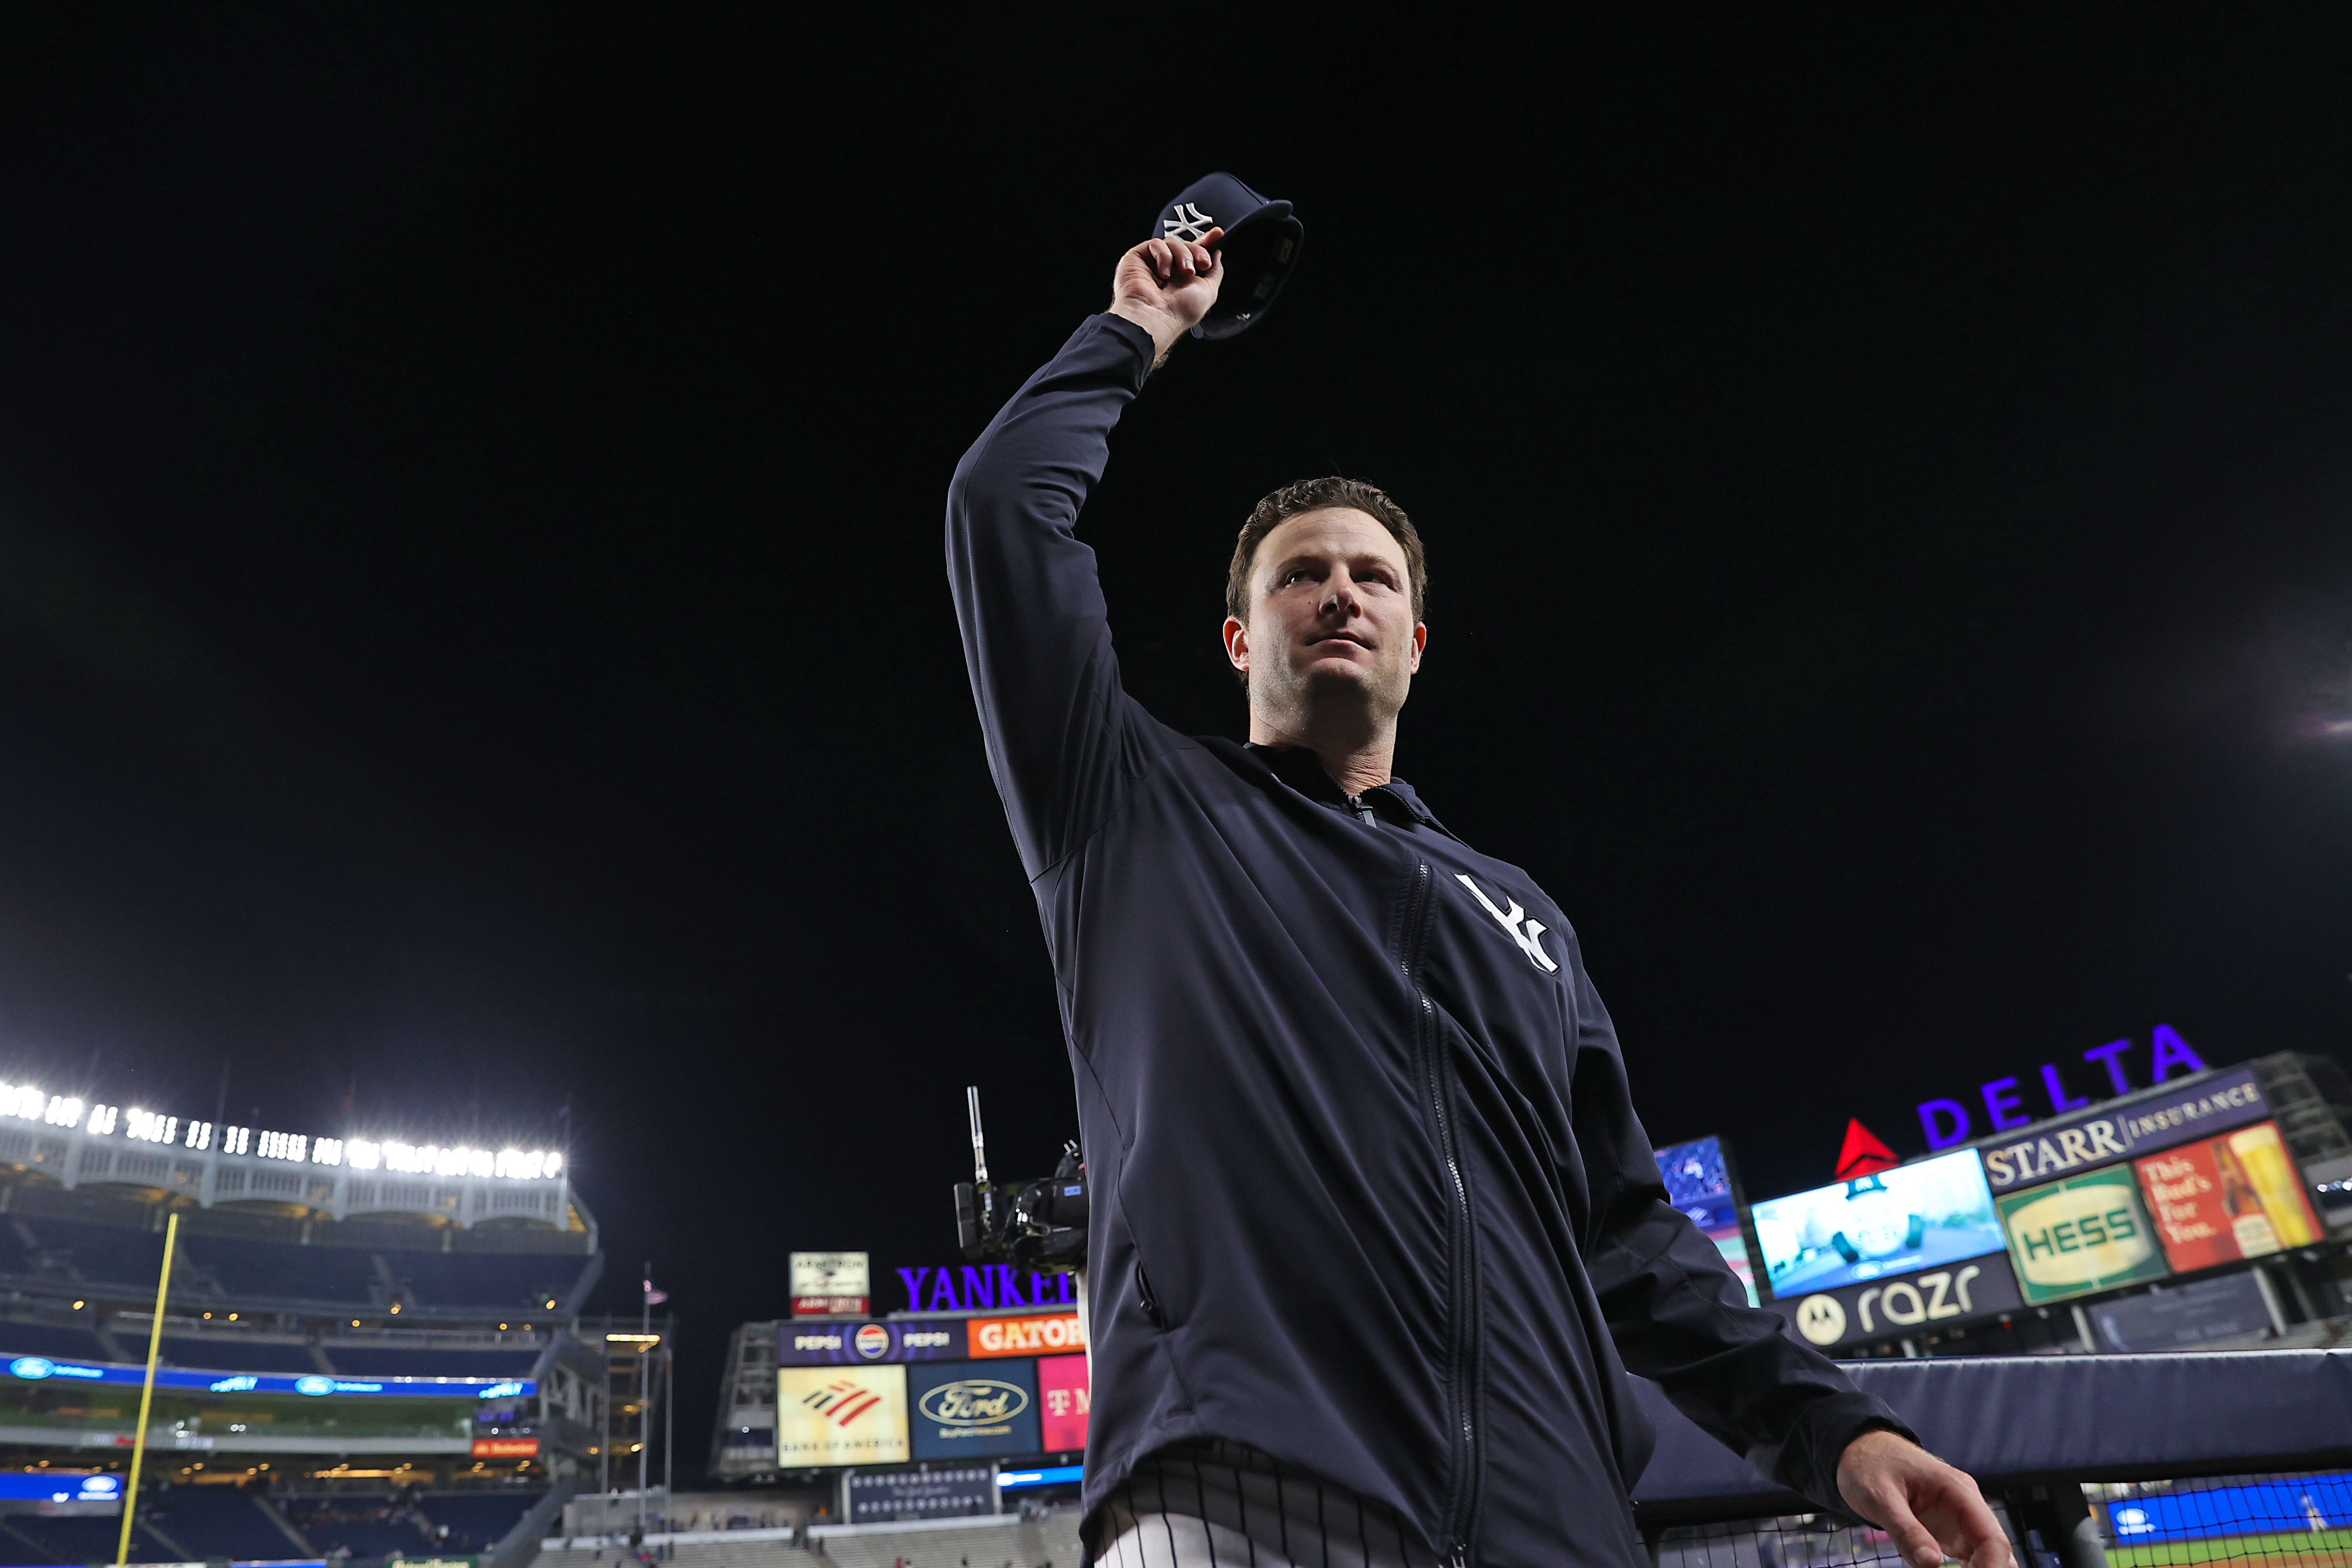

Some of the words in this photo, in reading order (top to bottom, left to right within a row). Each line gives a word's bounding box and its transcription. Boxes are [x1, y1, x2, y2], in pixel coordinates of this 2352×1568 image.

[1916, 1023, 2207, 1152] DELTA
[1986, 1120, 2127, 1186] STARR
[2128, 1082, 2260, 1138] INSURANCE
[2141, 1156, 2195, 1182] This
[2152, 1176, 2212, 1202] Bud's
[2024, 1208, 2136, 1261] HESS
[1857, 1265, 1980, 1333] razr
[795, 1335, 842, 1351] PEPSI
[903, 1332, 950, 1348] PEPSI
[938, 1386, 1010, 1418] Ford
